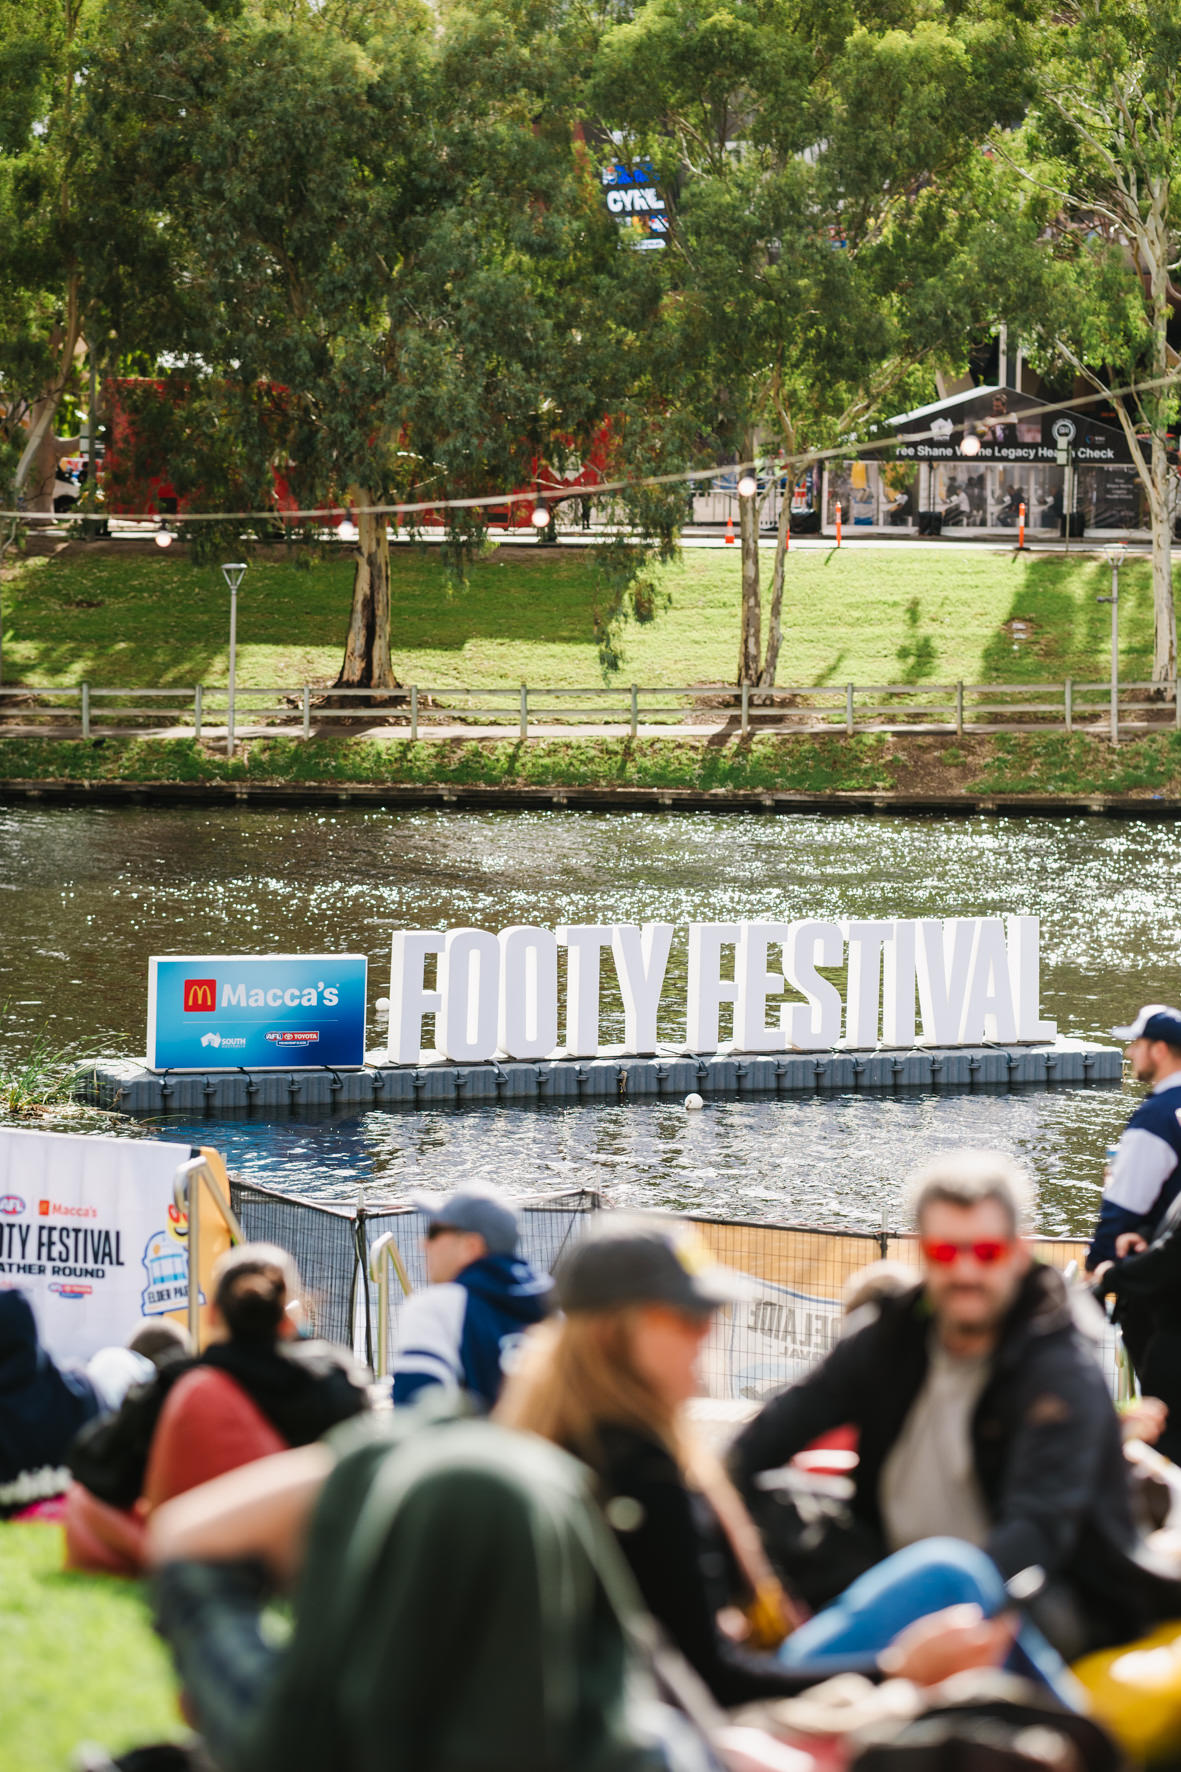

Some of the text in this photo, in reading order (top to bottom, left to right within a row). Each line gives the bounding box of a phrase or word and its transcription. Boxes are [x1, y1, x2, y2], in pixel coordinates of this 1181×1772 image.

[896, 447, 914, 456] ree
[917, 445, 953, 456] Shane
[994, 445, 1036, 460] Legacy
[1077, 447, 1114, 459] Check
[221, 981, 339, 1007] Macca's
[389, 916, 1057, 1065] FOOTY FESTIVAL
[221, 1037, 246, 1045] SOUTH
[52, 1204, 97, 1218] Macca's
[37, 1225, 125, 1267] FESTIVAL
[52, 1265, 105, 1279] ROUND
